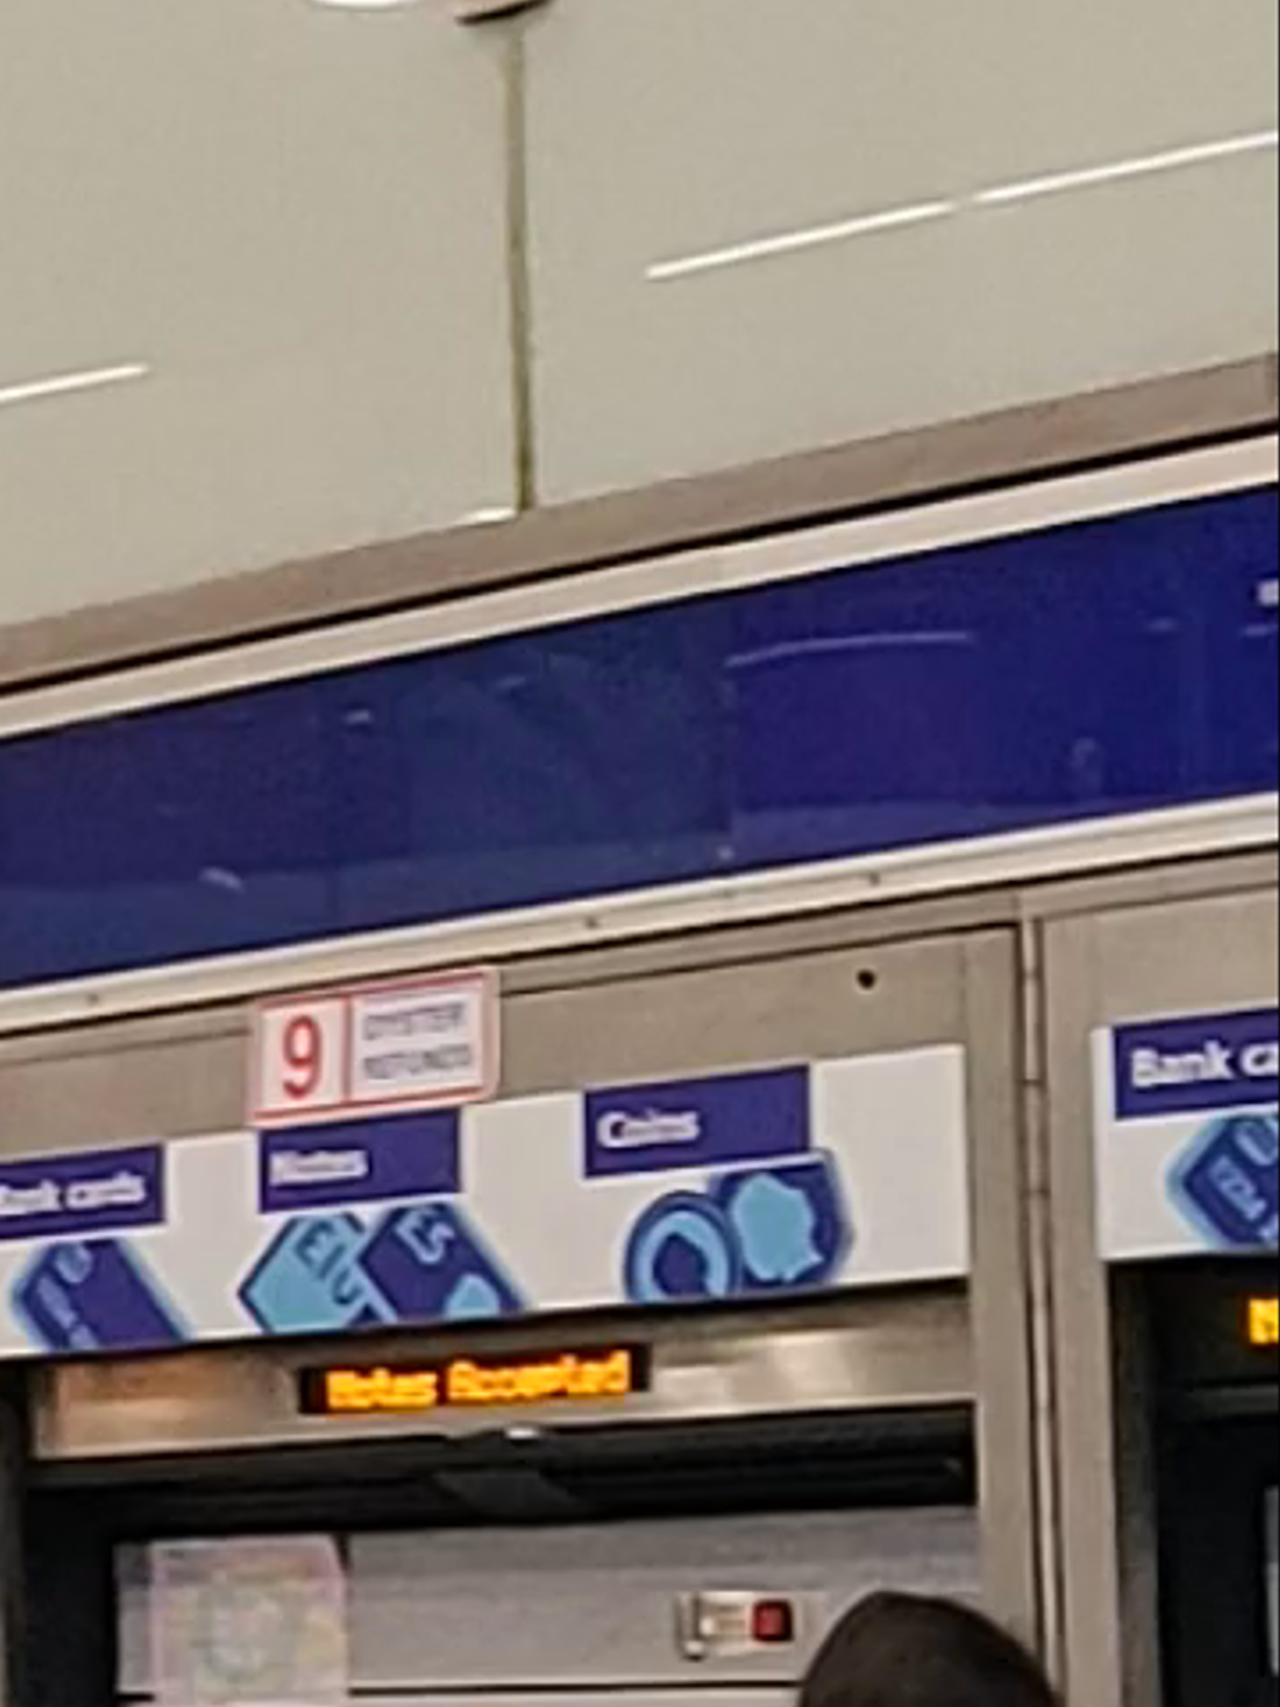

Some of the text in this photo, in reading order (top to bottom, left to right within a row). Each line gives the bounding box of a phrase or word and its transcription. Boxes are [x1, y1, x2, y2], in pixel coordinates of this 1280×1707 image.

[282, 1015, 324, 1099] 9
[1130, 1041, 1235, 1088] Bank
[596, 1108, 702, 1148] Coins
